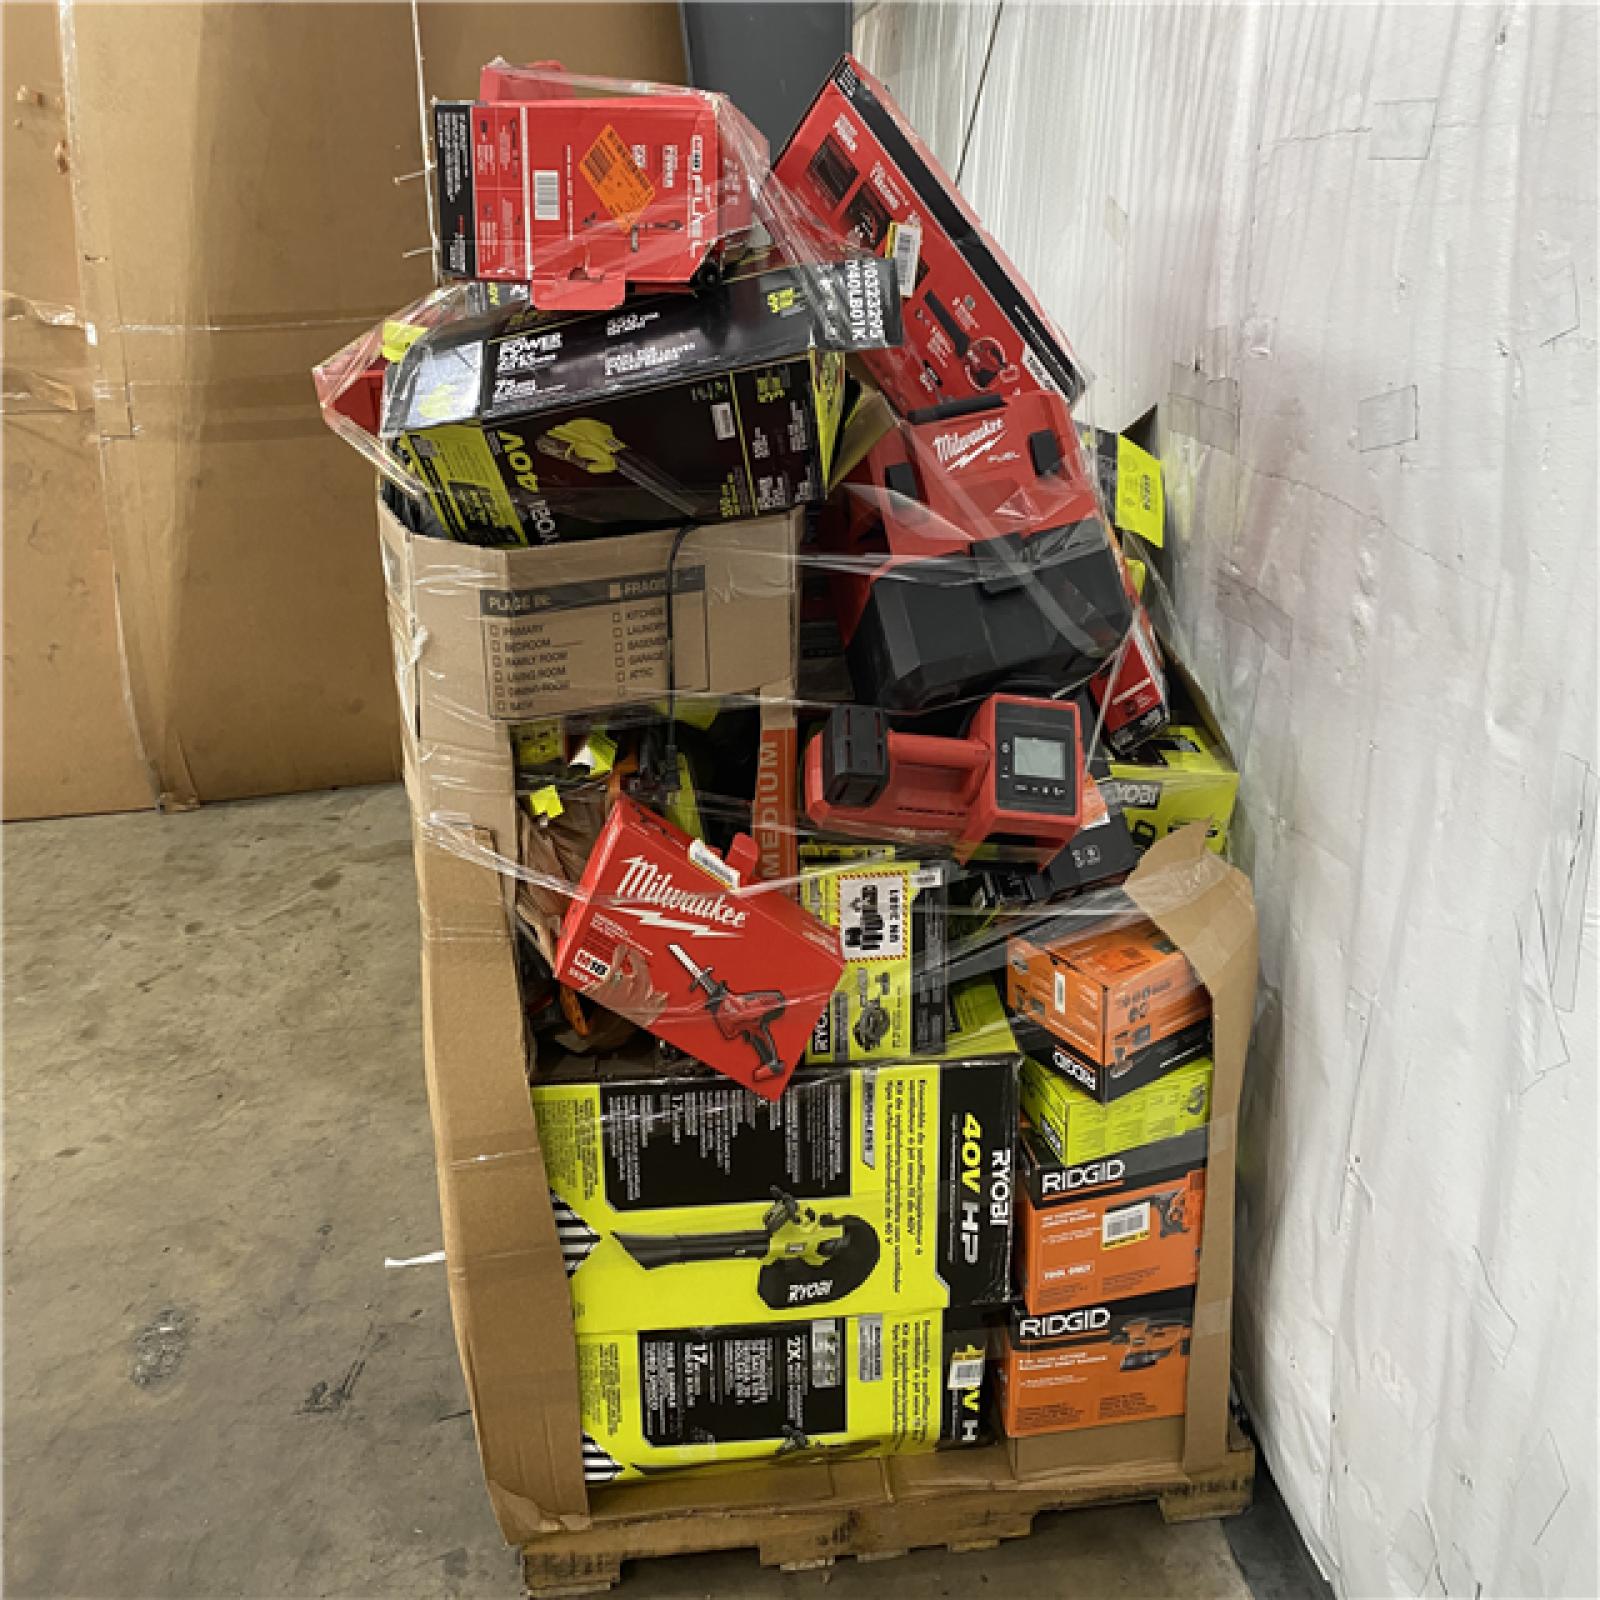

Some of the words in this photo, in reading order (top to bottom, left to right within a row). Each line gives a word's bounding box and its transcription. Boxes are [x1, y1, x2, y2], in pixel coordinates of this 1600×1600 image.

[933, 418, 1004, 461] Milwaukee
[498, 432, 538, 493] 40V
[529, 499, 560, 544] YOBI
[505, 639, 551, 653] BEDROOM
[539, 651, 568, 664] ROOM
[537, 666, 566, 680] ROOM
[761, 740, 779, 879] MEDIUM
[614, 855, 748, 929] Milwaukee
[961, 1112, 982, 1193] 40V
[989, 1148, 1011, 1226] RYOBI
[1041, 1159, 1126, 1194] RIDGID
[960, 1201, 978, 1264] HP
[787, 1277, 834, 1302] RYOBI
[1019, 1307, 1111, 1338] RIDGID
[691, 1342, 708, 1365] 17
